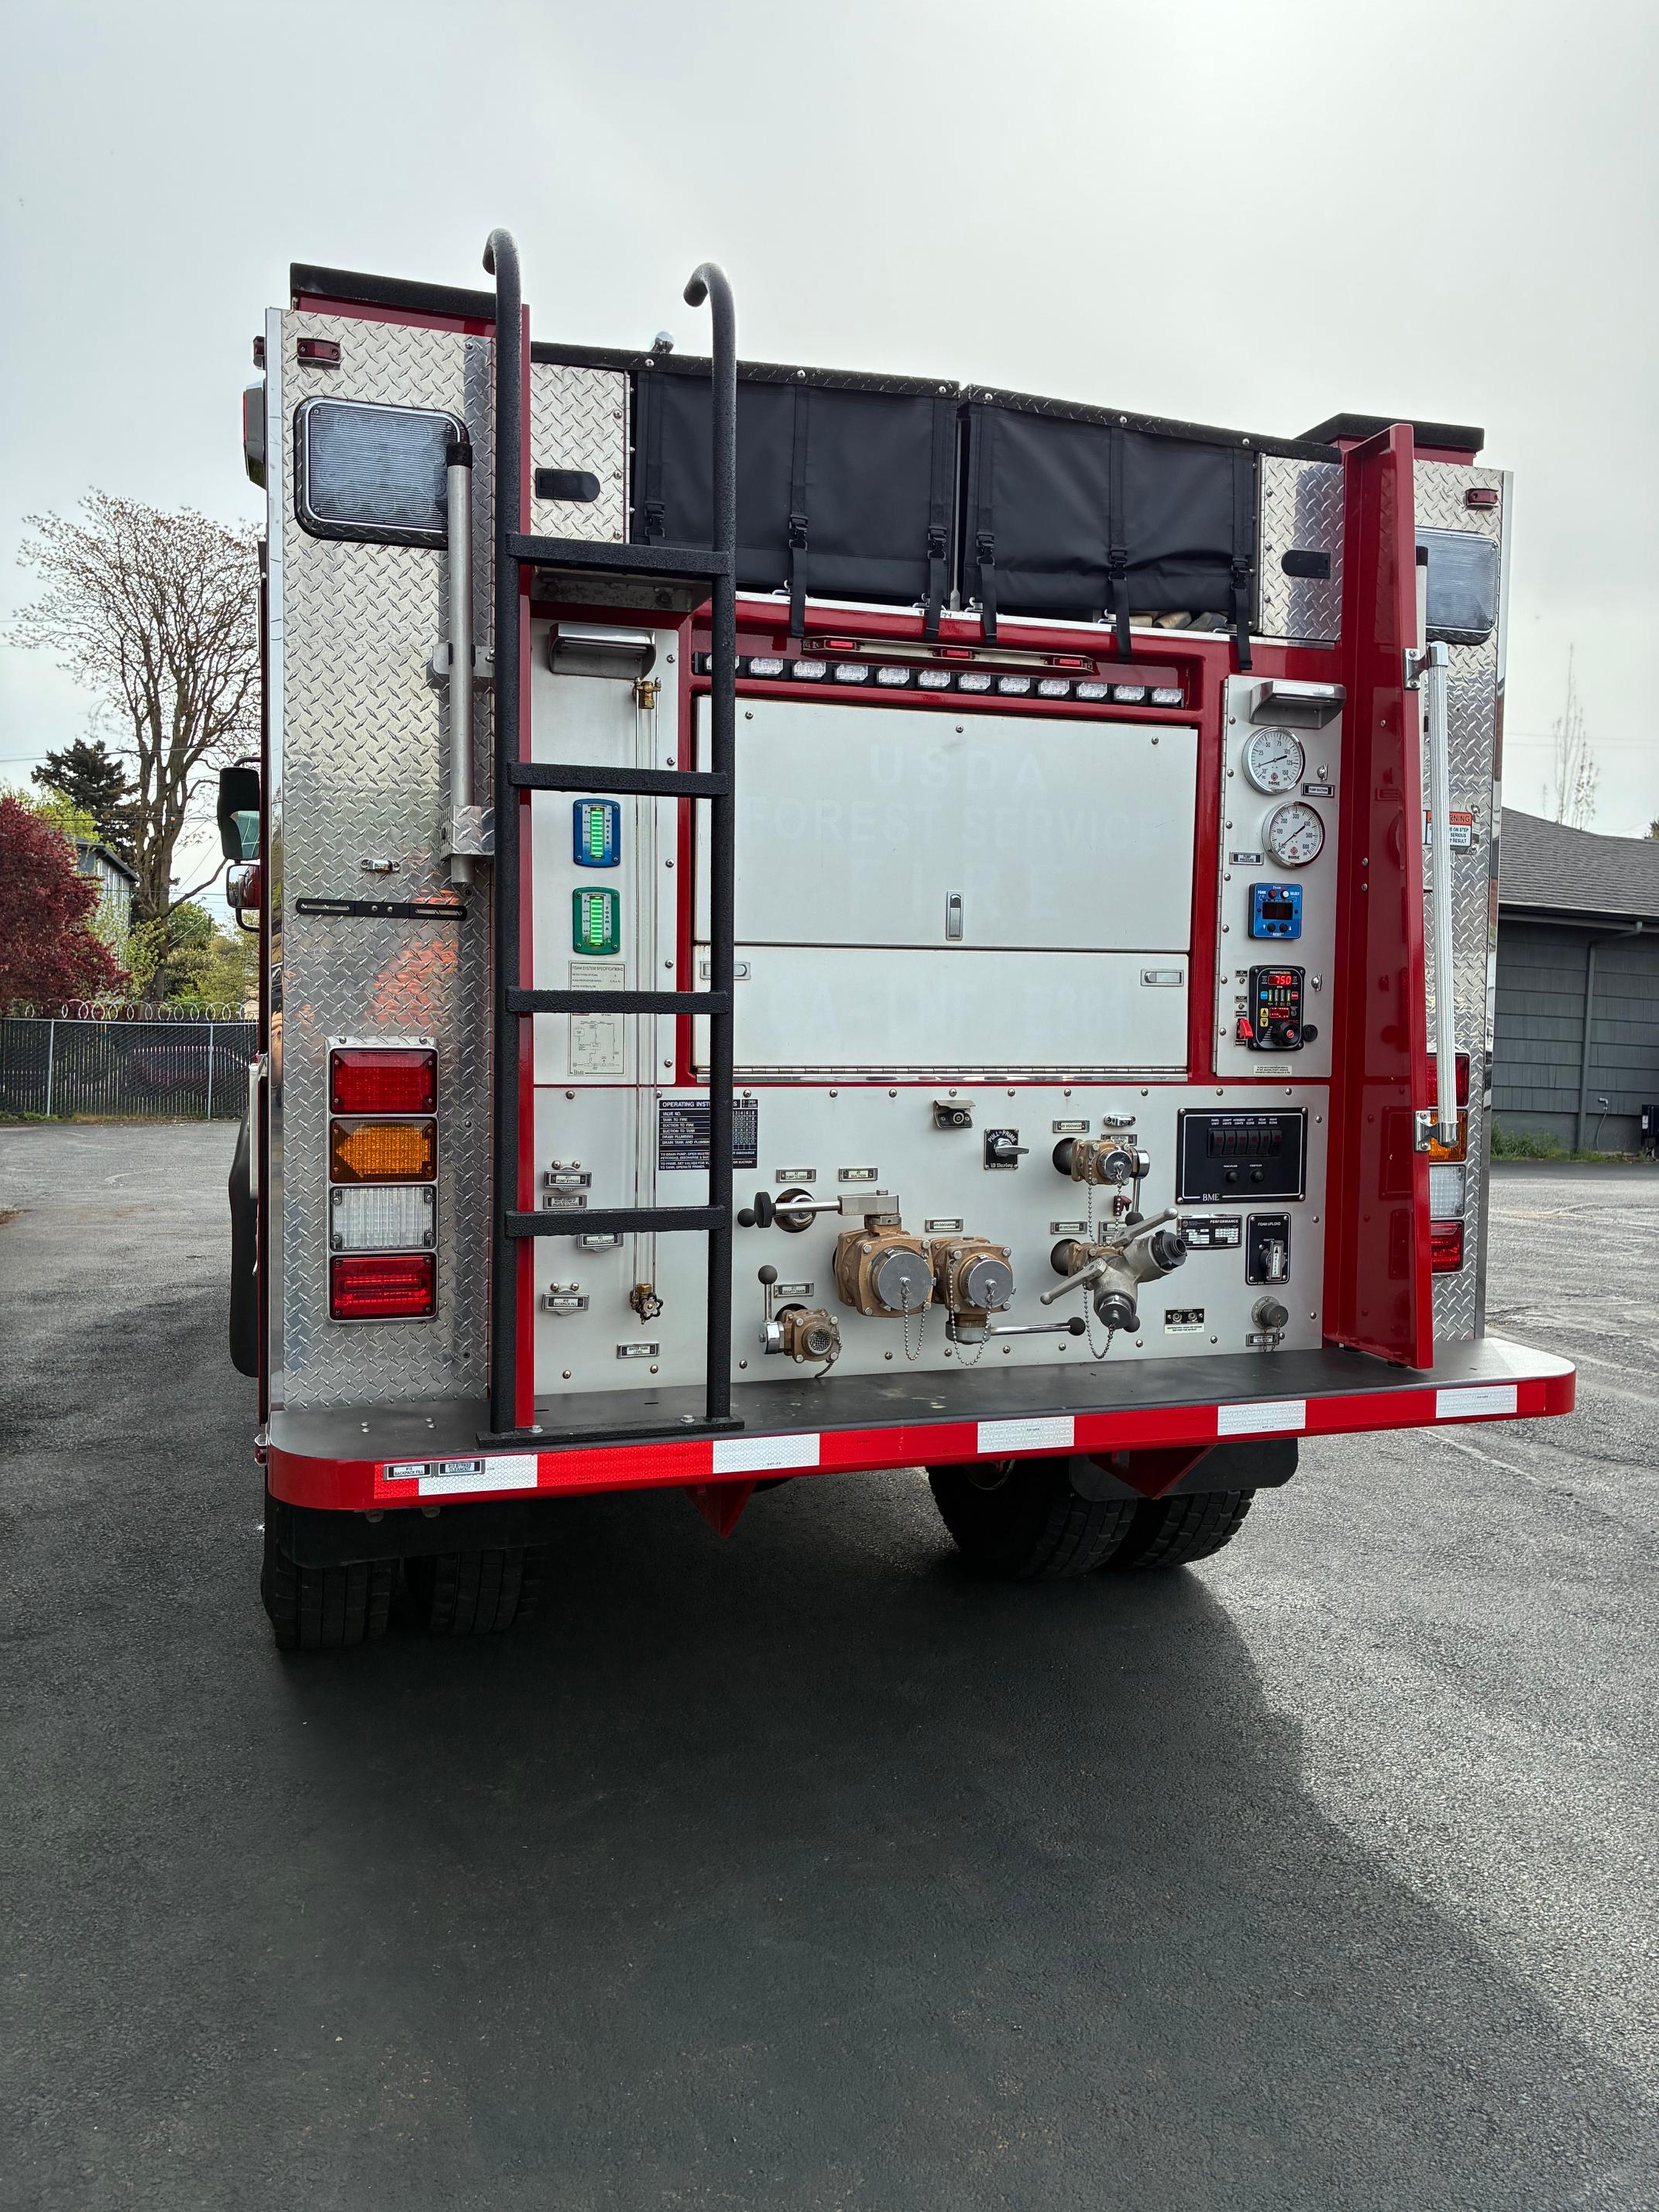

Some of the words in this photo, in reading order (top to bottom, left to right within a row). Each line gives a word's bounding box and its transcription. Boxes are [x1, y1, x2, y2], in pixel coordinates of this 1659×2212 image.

[870, 744, 1046, 794] USDA
[1276, 976, 1292, 984] 750
[988, 1132, 1000, 1142] PULL
[1002, 1130, 1017, 1142] PRIME
